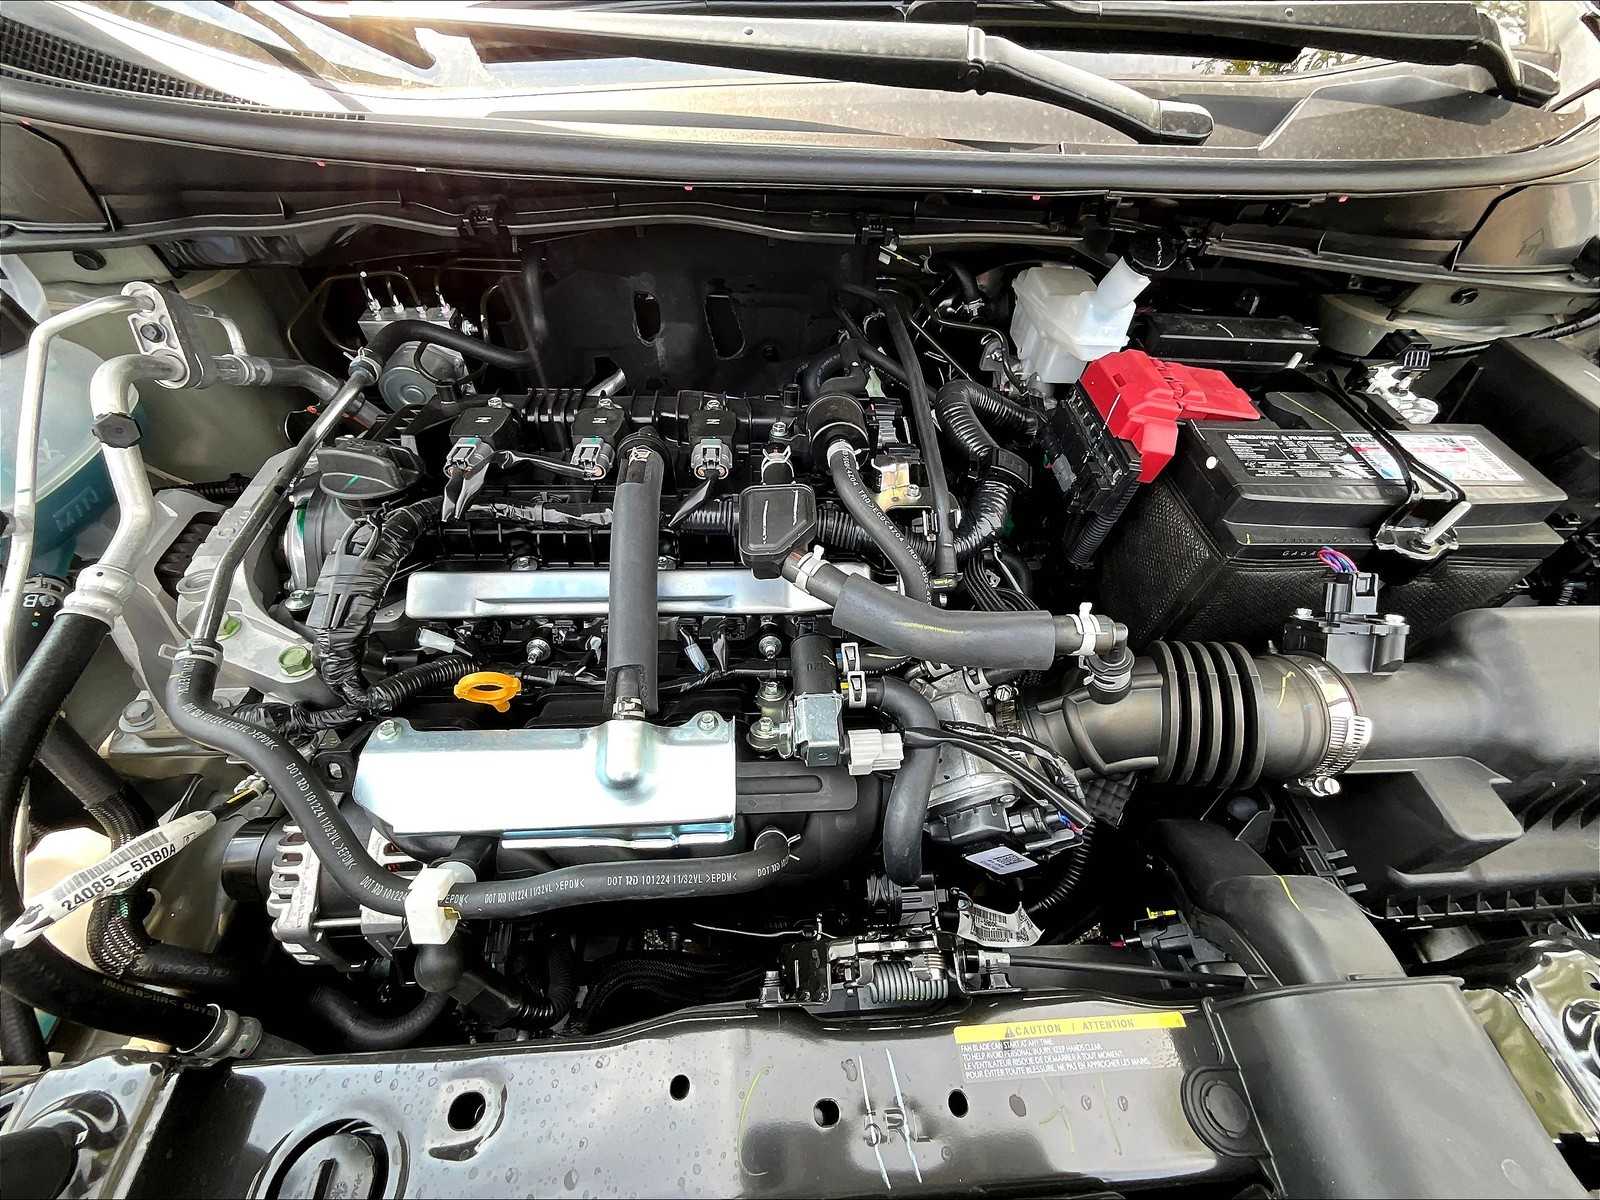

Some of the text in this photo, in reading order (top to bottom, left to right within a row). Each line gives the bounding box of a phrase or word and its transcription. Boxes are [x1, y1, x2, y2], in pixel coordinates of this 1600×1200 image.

[286, 762, 302, 779] DOT
[607, 876, 623, 886] DOT
[641, 872, 670, 885] 101224
[1015, 1024, 1062, 1035] CAUTION
[1082, 1018, 1135, 1031] ATTENTION
